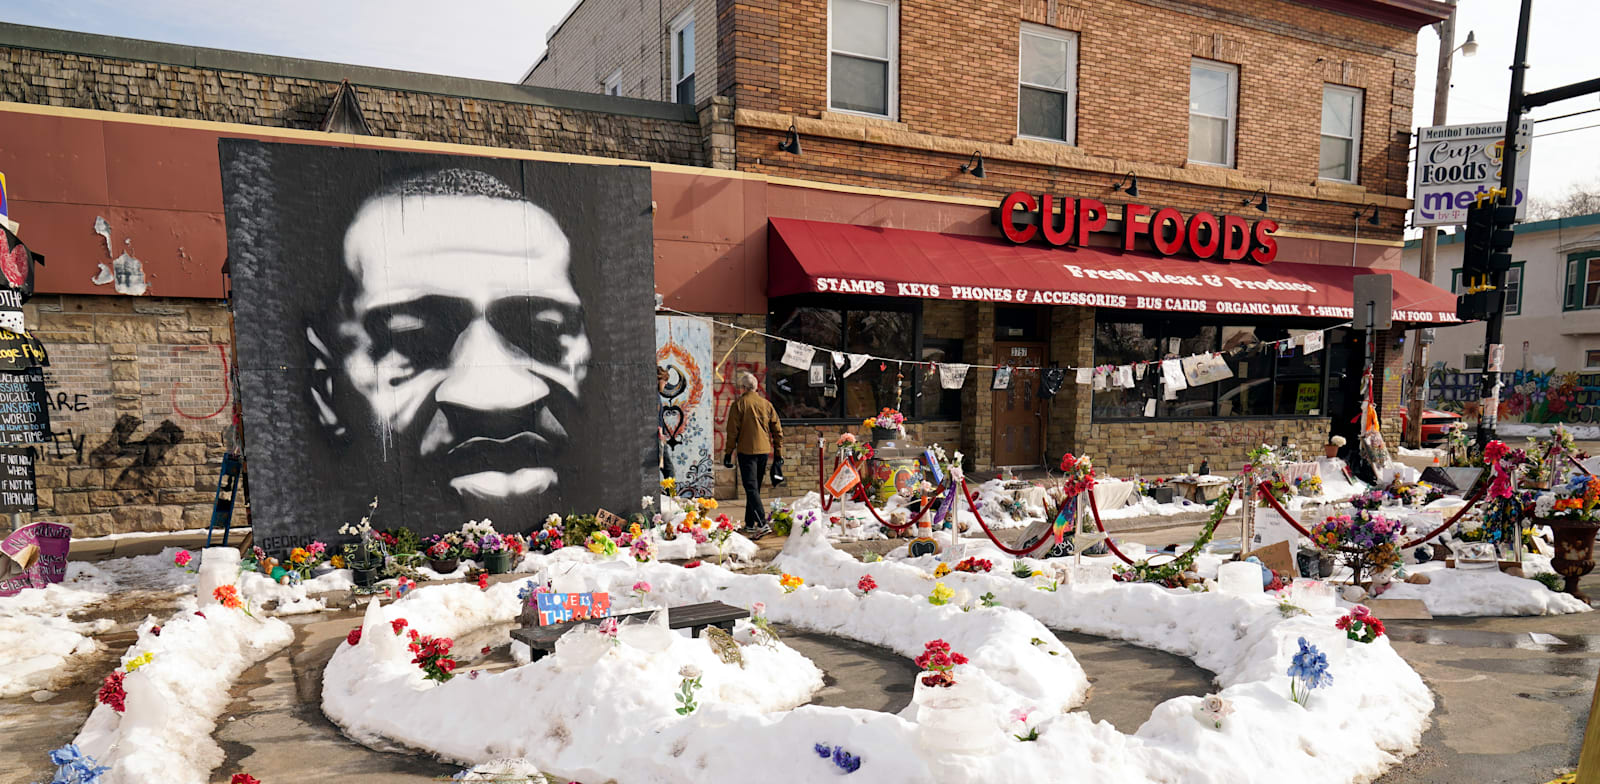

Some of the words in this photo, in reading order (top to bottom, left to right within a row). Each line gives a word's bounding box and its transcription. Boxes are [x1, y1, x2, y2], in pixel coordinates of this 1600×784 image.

[1426, 127, 1462, 139] Menthol
[1465, 125, 1502, 137] Tobacco
[1429, 140, 1486, 165] Cup
[1423, 161, 1487, 184] Foods
[999, 190, 1108, 248] CUP
[1124, 202, 1279, 265] FOODS
[1063, 264, 1142, 282] Fresh
[1138, 270, 1203, 286] Meat
[1202, 274, 1223, 287] &
[1224, 276, 1317, 293] Produce
[816, 277, 885, 294] STAMPS
[897, 282, 940, 297] KEYS
[951, 285, 1012, 301] PHONES
[1016, 289, 1028, 302] &
[1032, 290, 1127, 307] ACCESSORIES
[1136, 296, 1162, 309] BUS
[1165, 298, 1207, 311] CARDS
[1216, 301, 1270, 314] ORGANIC
[1272, 304, 1301, 315] MILK
[1308, 305, 1354, 318] T-SHIRTS
[1408, 312, 1433, 321] FOOD
[1, 413, 37, 424] WORLD
[1, 454, 6, 463] IF
[2, 480, 7, 490] IF
[9, 480, 23, 490] NOT
[2, 492, 20, 505] THEN
[544, 594, 577, 607] LOVE
[541, 609, 572, 625] THE
